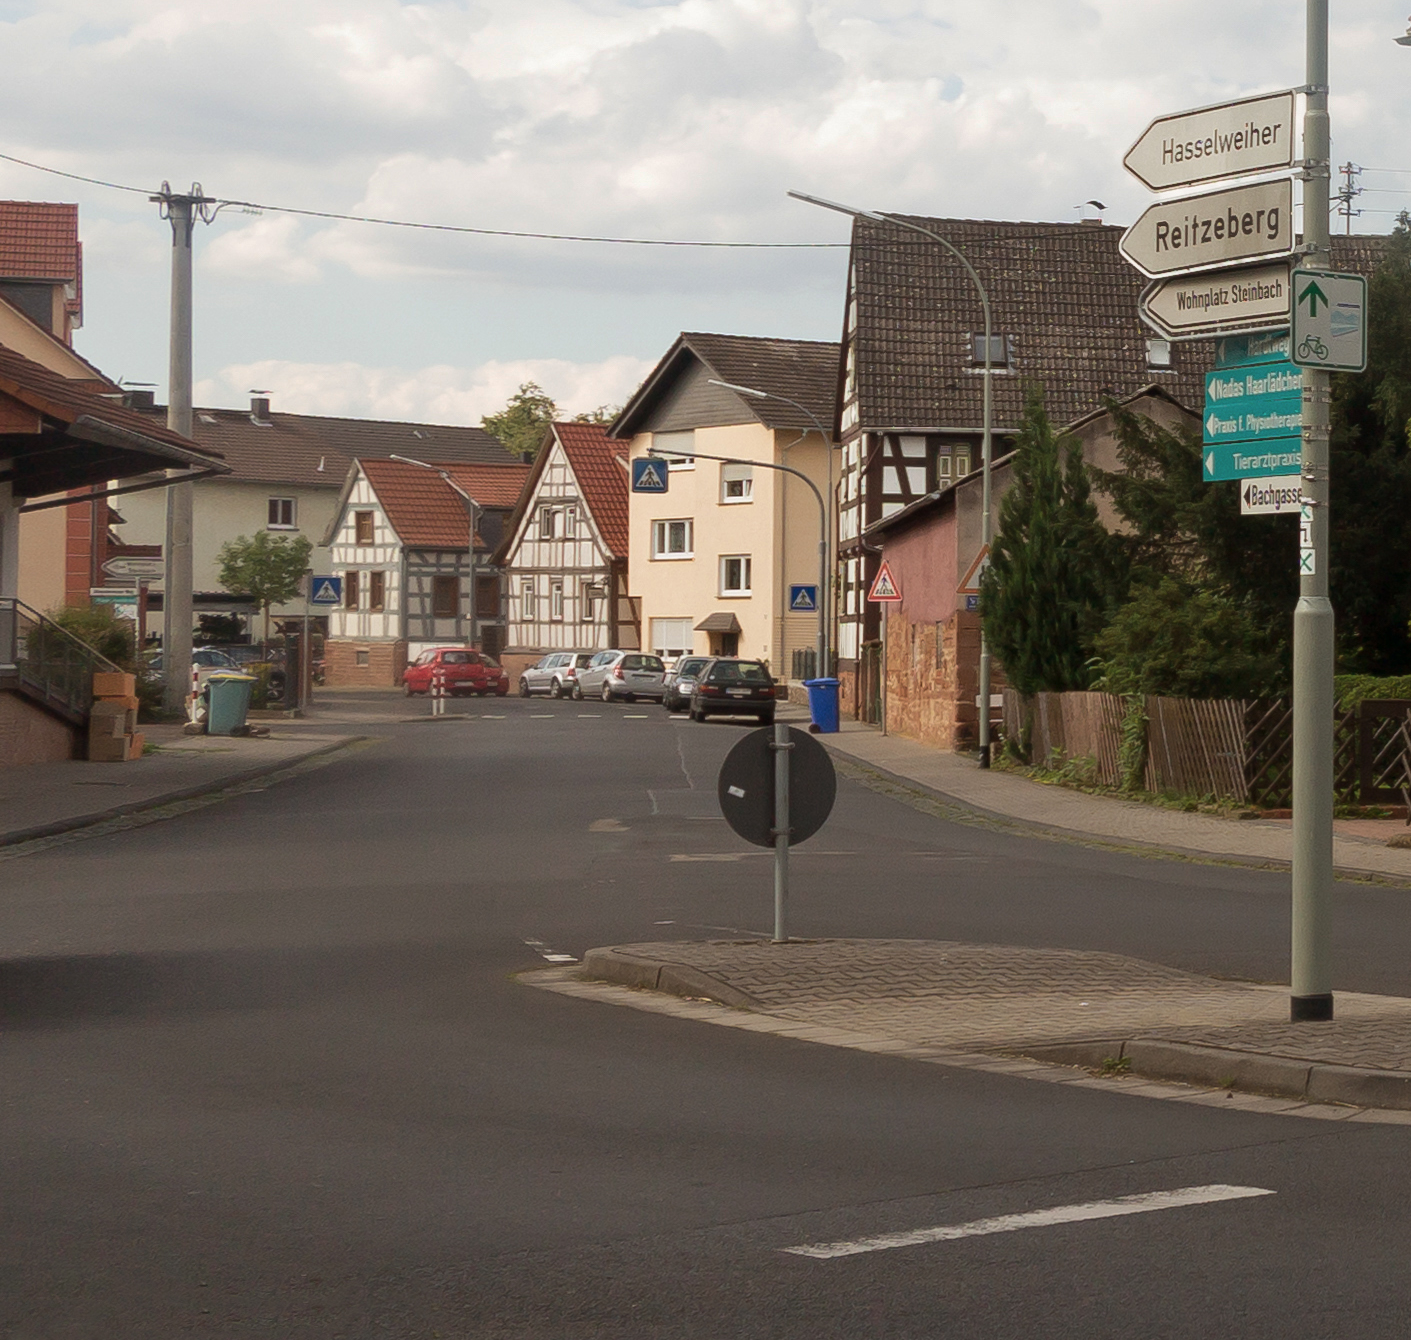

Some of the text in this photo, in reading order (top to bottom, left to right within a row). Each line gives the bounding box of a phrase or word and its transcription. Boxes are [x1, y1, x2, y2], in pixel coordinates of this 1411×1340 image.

[1162, 122, 1282, 165] Hasselweiher
[1156, 207, 1280, 253] Reitzeberg
[1176, 279, 1283, 312] Wohnplatz Steinbach
[1214, 416, 1237, 434] Praxis
[1232, 448, 1302, 471] Tierarztpraxis
[1251, 483, 1303, 510] Bachgasse
